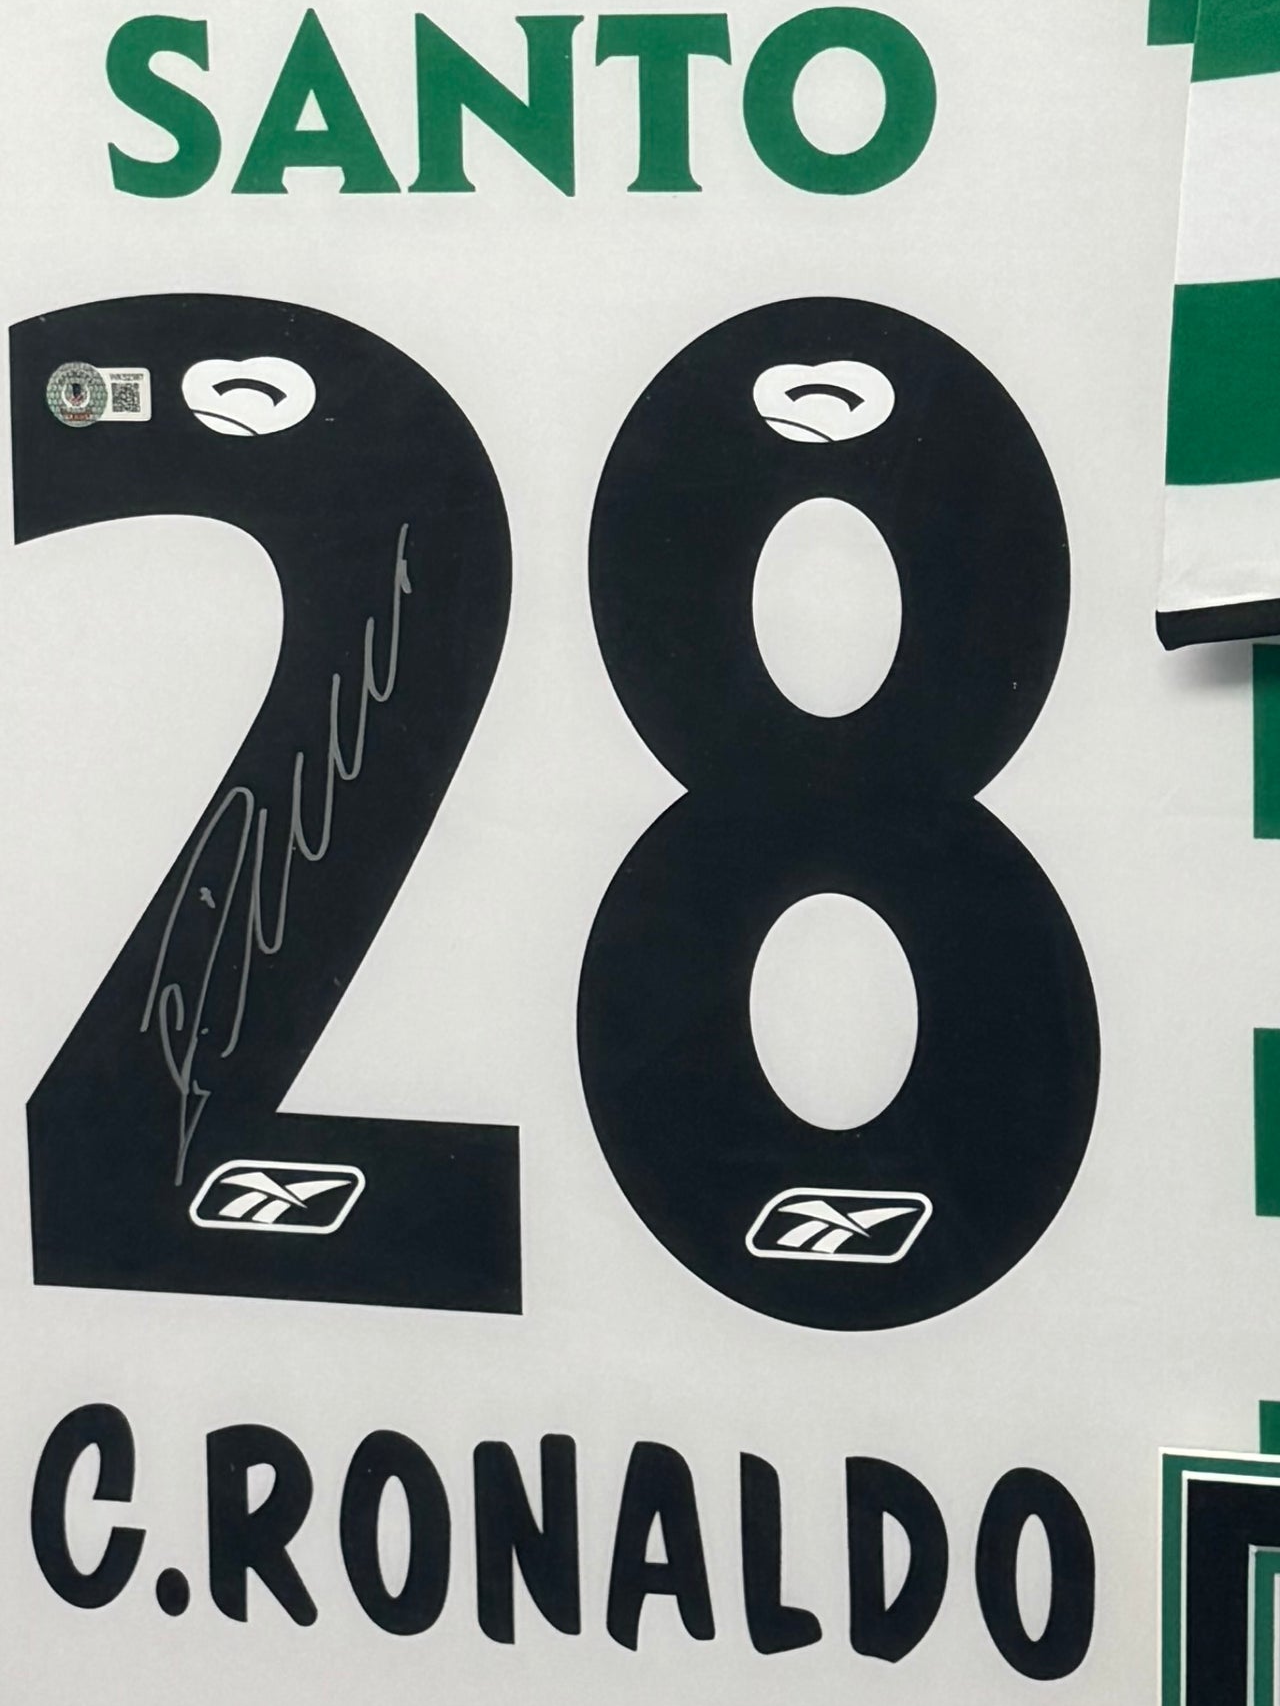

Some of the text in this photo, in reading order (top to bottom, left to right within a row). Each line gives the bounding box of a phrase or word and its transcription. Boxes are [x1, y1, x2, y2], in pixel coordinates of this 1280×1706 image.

[105, 6, 937, 198] SANTO
[8, 292, 1101, 1331] 28
[30, 1403, 1096, 1680] C.RONALDO
